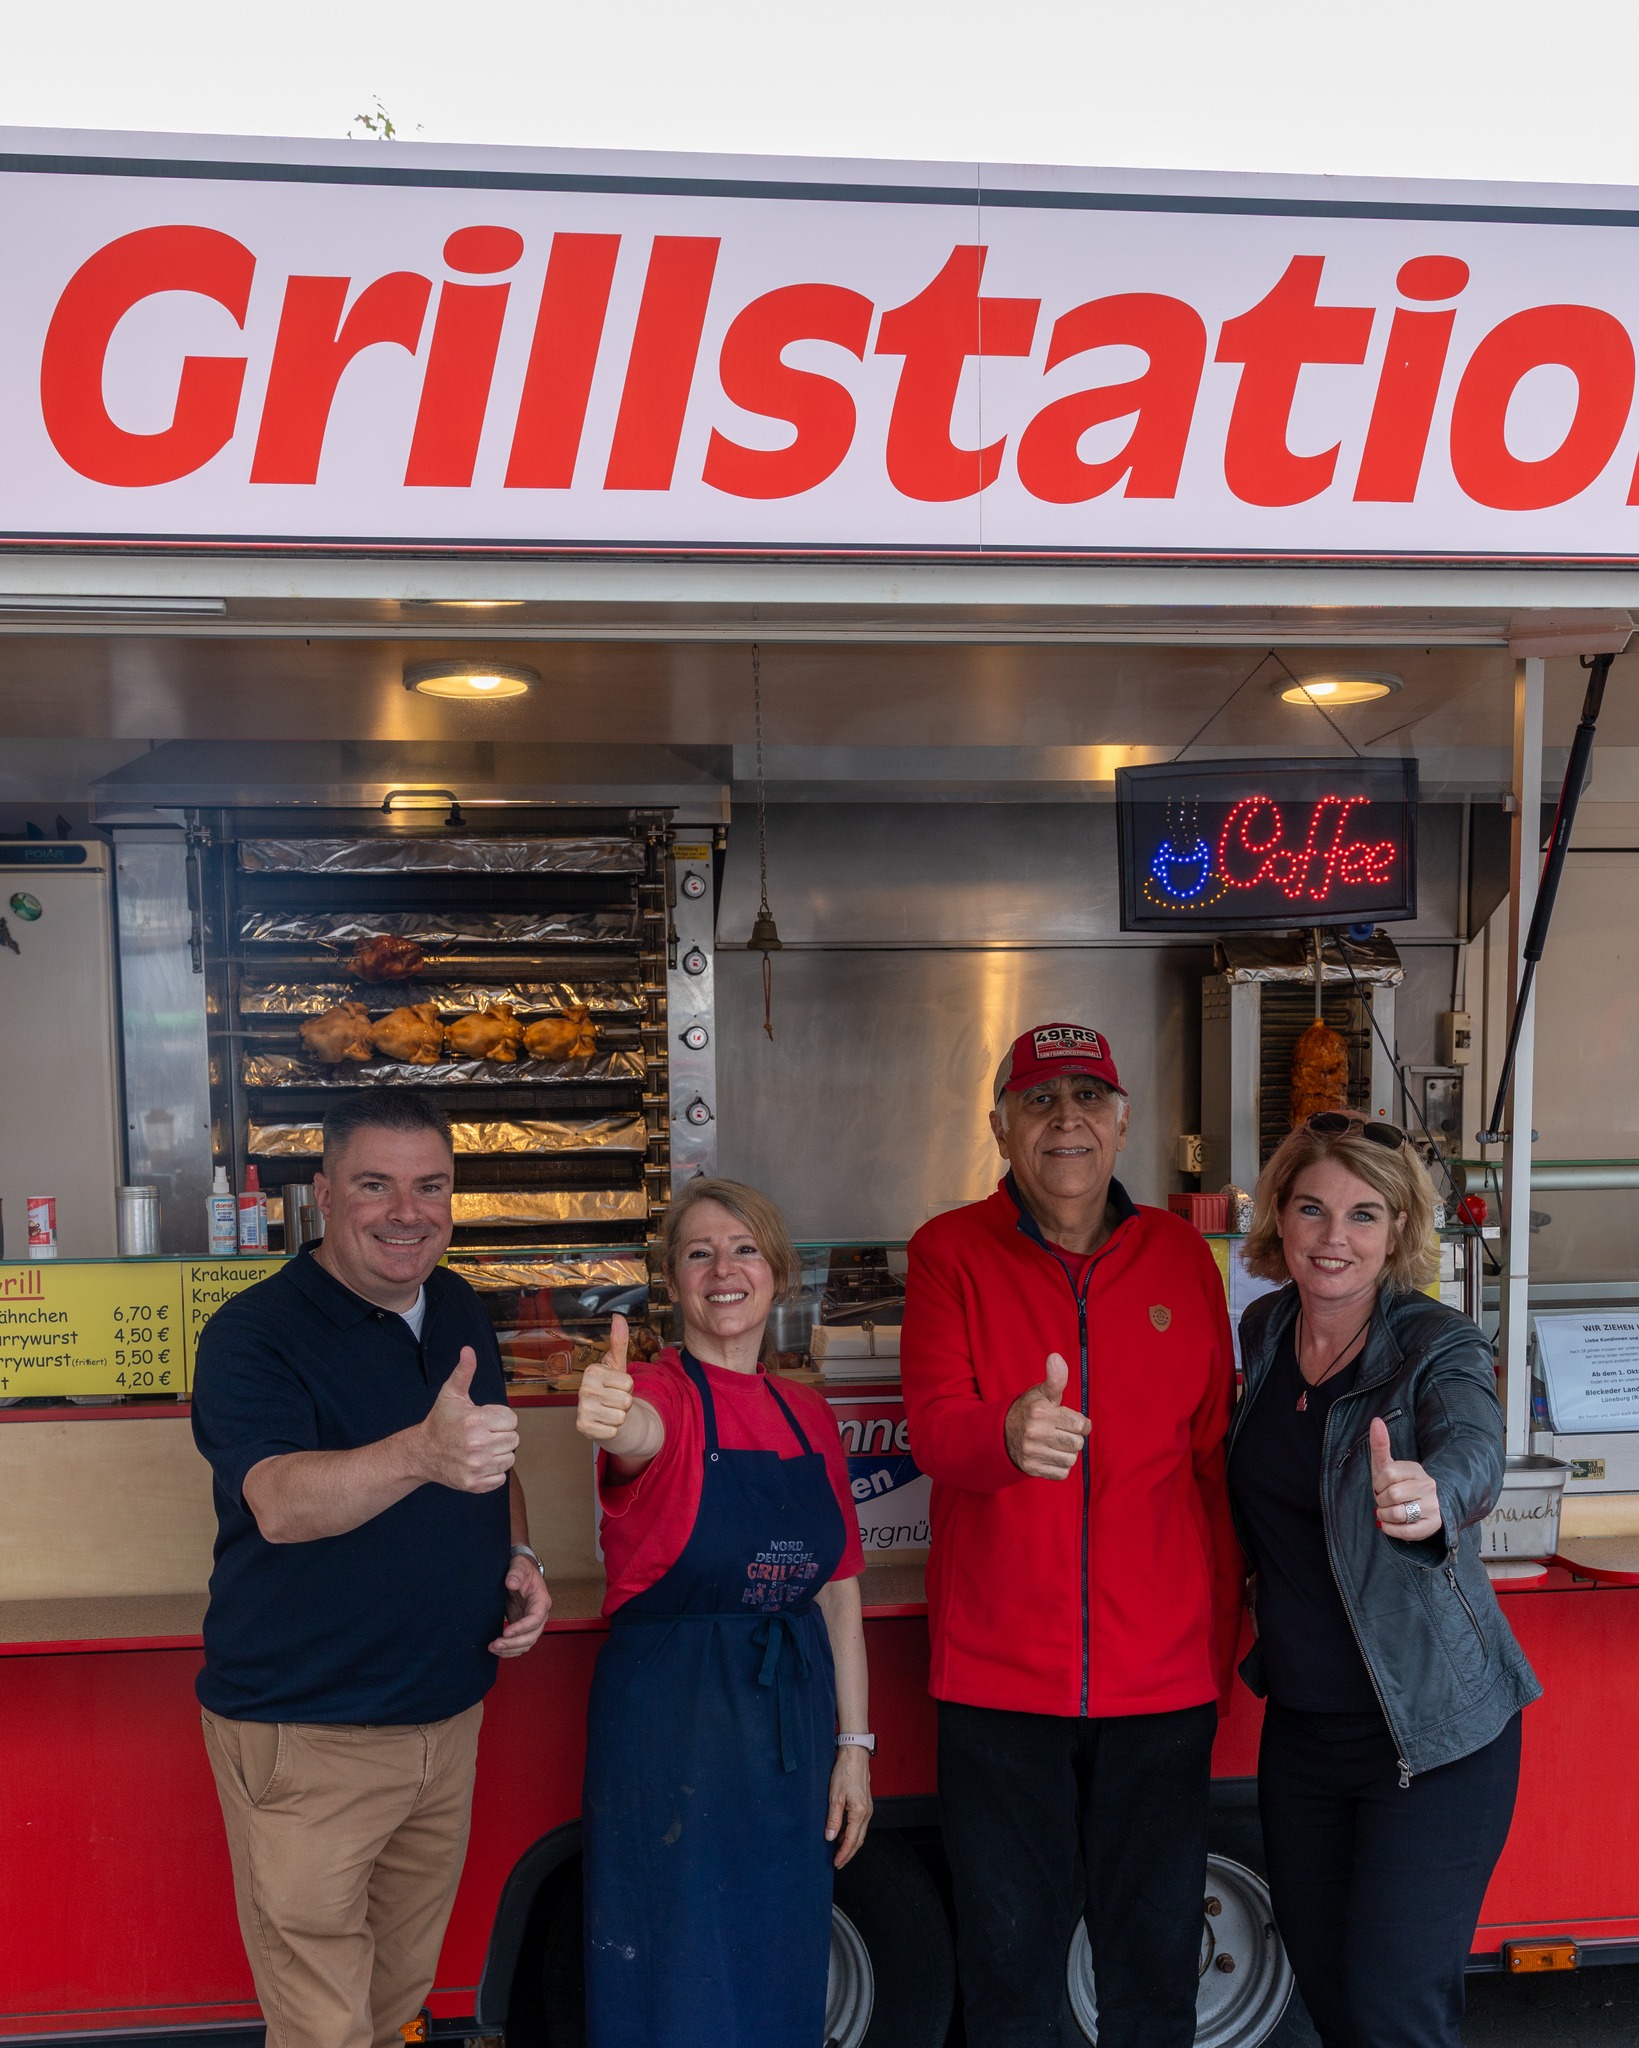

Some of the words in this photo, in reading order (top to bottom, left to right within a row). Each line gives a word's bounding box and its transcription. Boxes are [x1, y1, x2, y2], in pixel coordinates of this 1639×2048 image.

[41, 224, 1639, 511] Grillstatio
[1218, 796, 1395, 900] Coffee
[1036, 1029, 1097, 1042] 49ERS
[0, 1270, 41, 1295] rill
[191, 1266, 267, 1282] Krakauer
[113, 1305, 152, 1323] 6,70
[157, 1305, 169, 1320] €
[192, 1309, 215, 1323] Po
[0, 1331, 78, 1350] rrywurst
[114, 1328, 152, 1346] 4,50
[158, 1327, 169, 1342] €
[115, 1350, 153, 1367] 5,50
[158, 1349, 170, 1365] €
[115, 1372, 154, 1389] 4,20
[159, 1371, 171, 1386] €
[1585, 1388, 1621, 1396] Bleckeder
[860, 1520, 932, 1549] ergnü
[770, 1540, 804, 1551] NORD
[755, 1552, 814, 1564] DEUTSCHE
